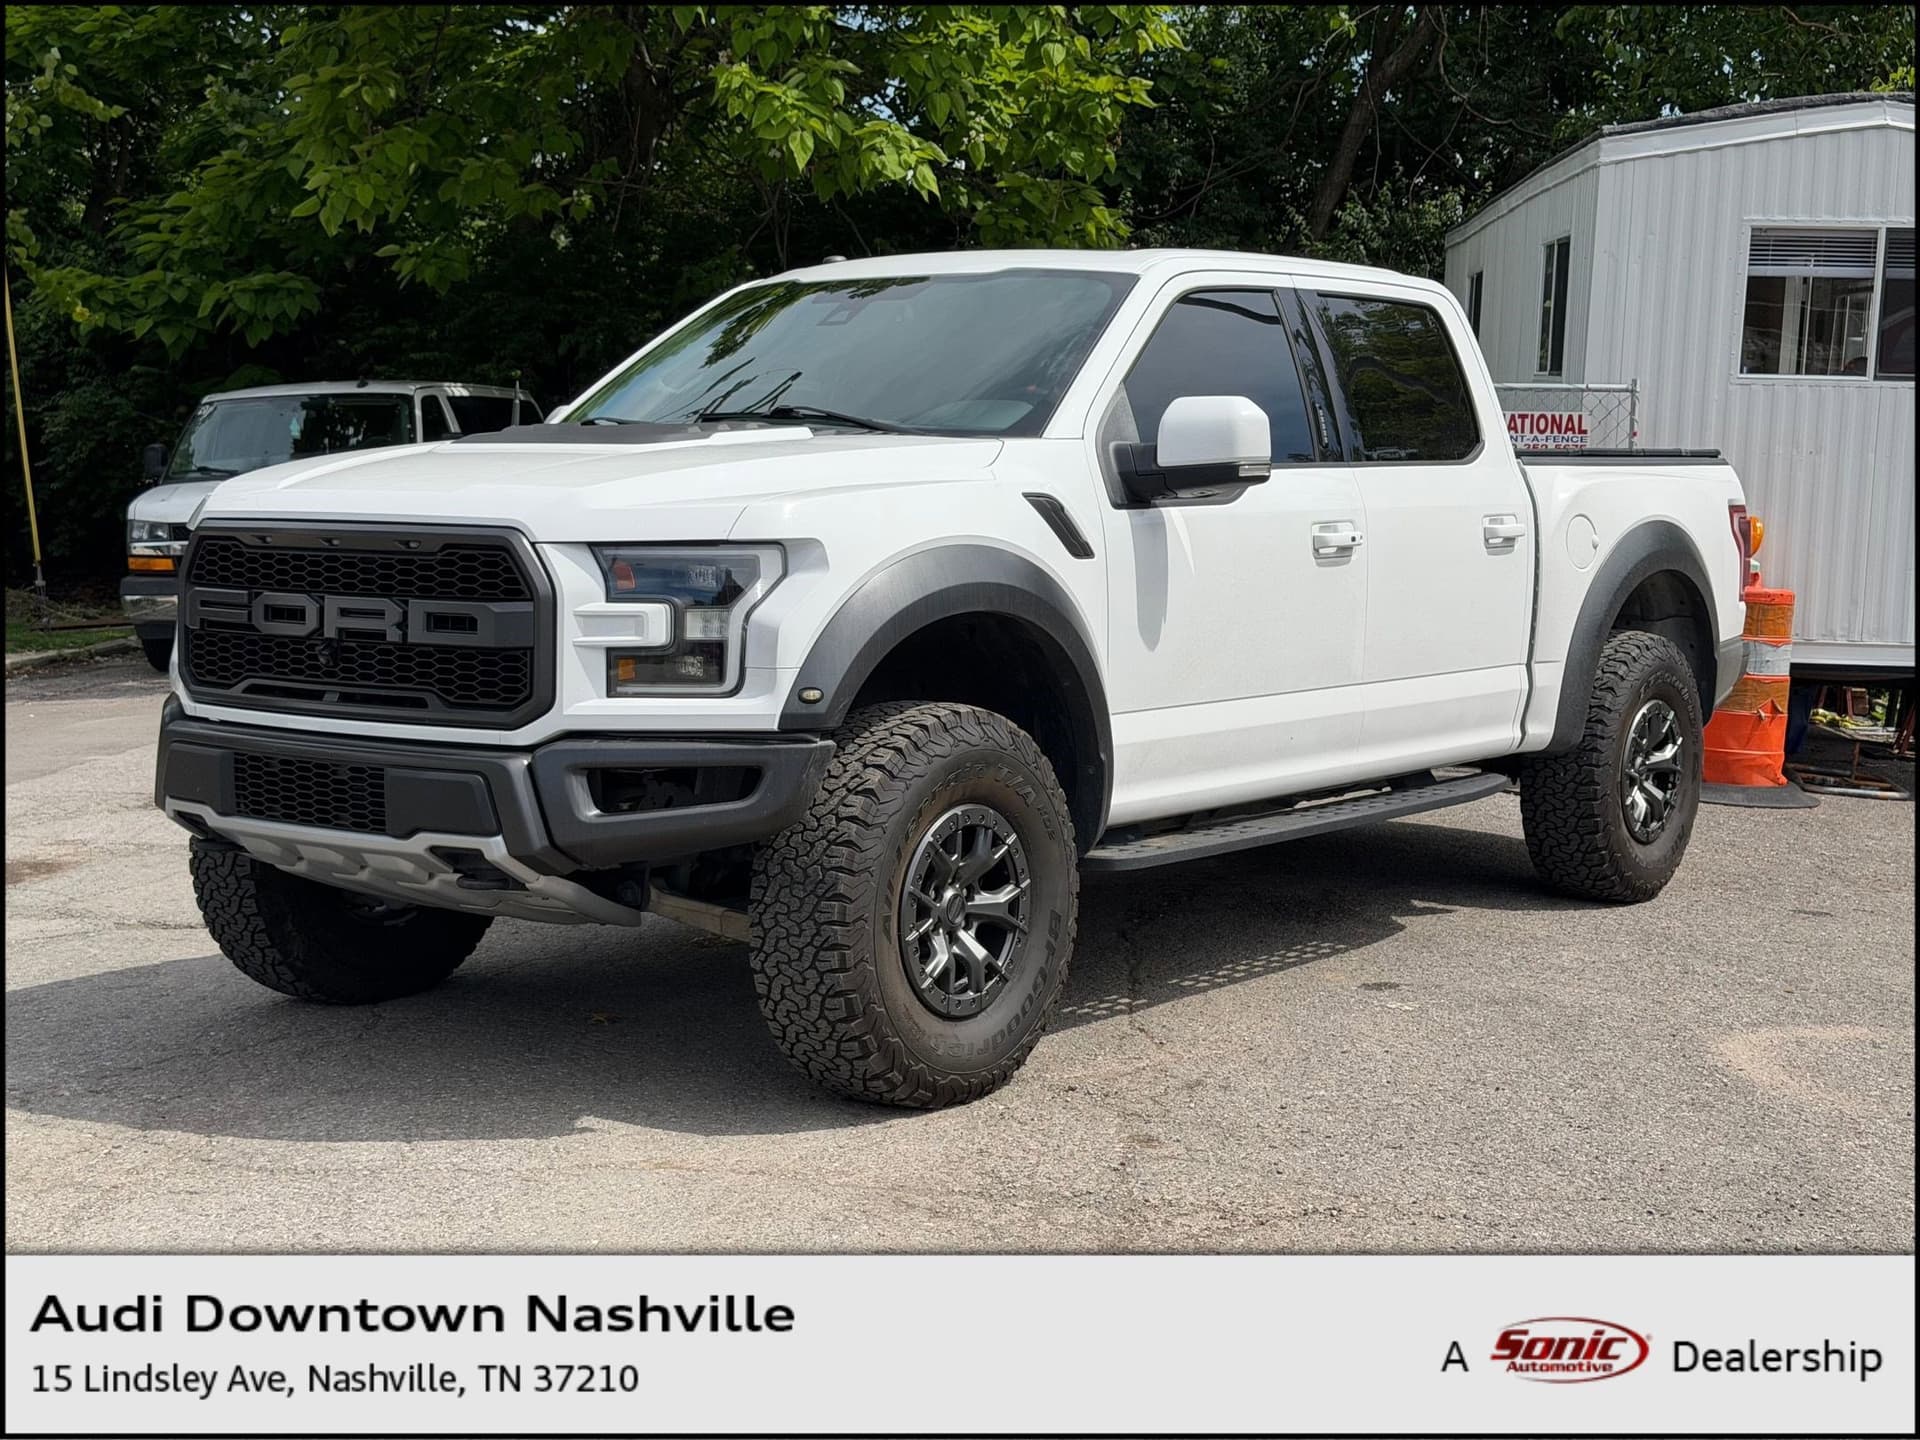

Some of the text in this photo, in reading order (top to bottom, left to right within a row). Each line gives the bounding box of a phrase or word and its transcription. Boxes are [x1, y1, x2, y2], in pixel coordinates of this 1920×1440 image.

[1503, 413, 1588, 435] ATIONAL
[1510, 435, 1588, 443] NT-A-FENCE
[188, 587, 515, 647] FORD
